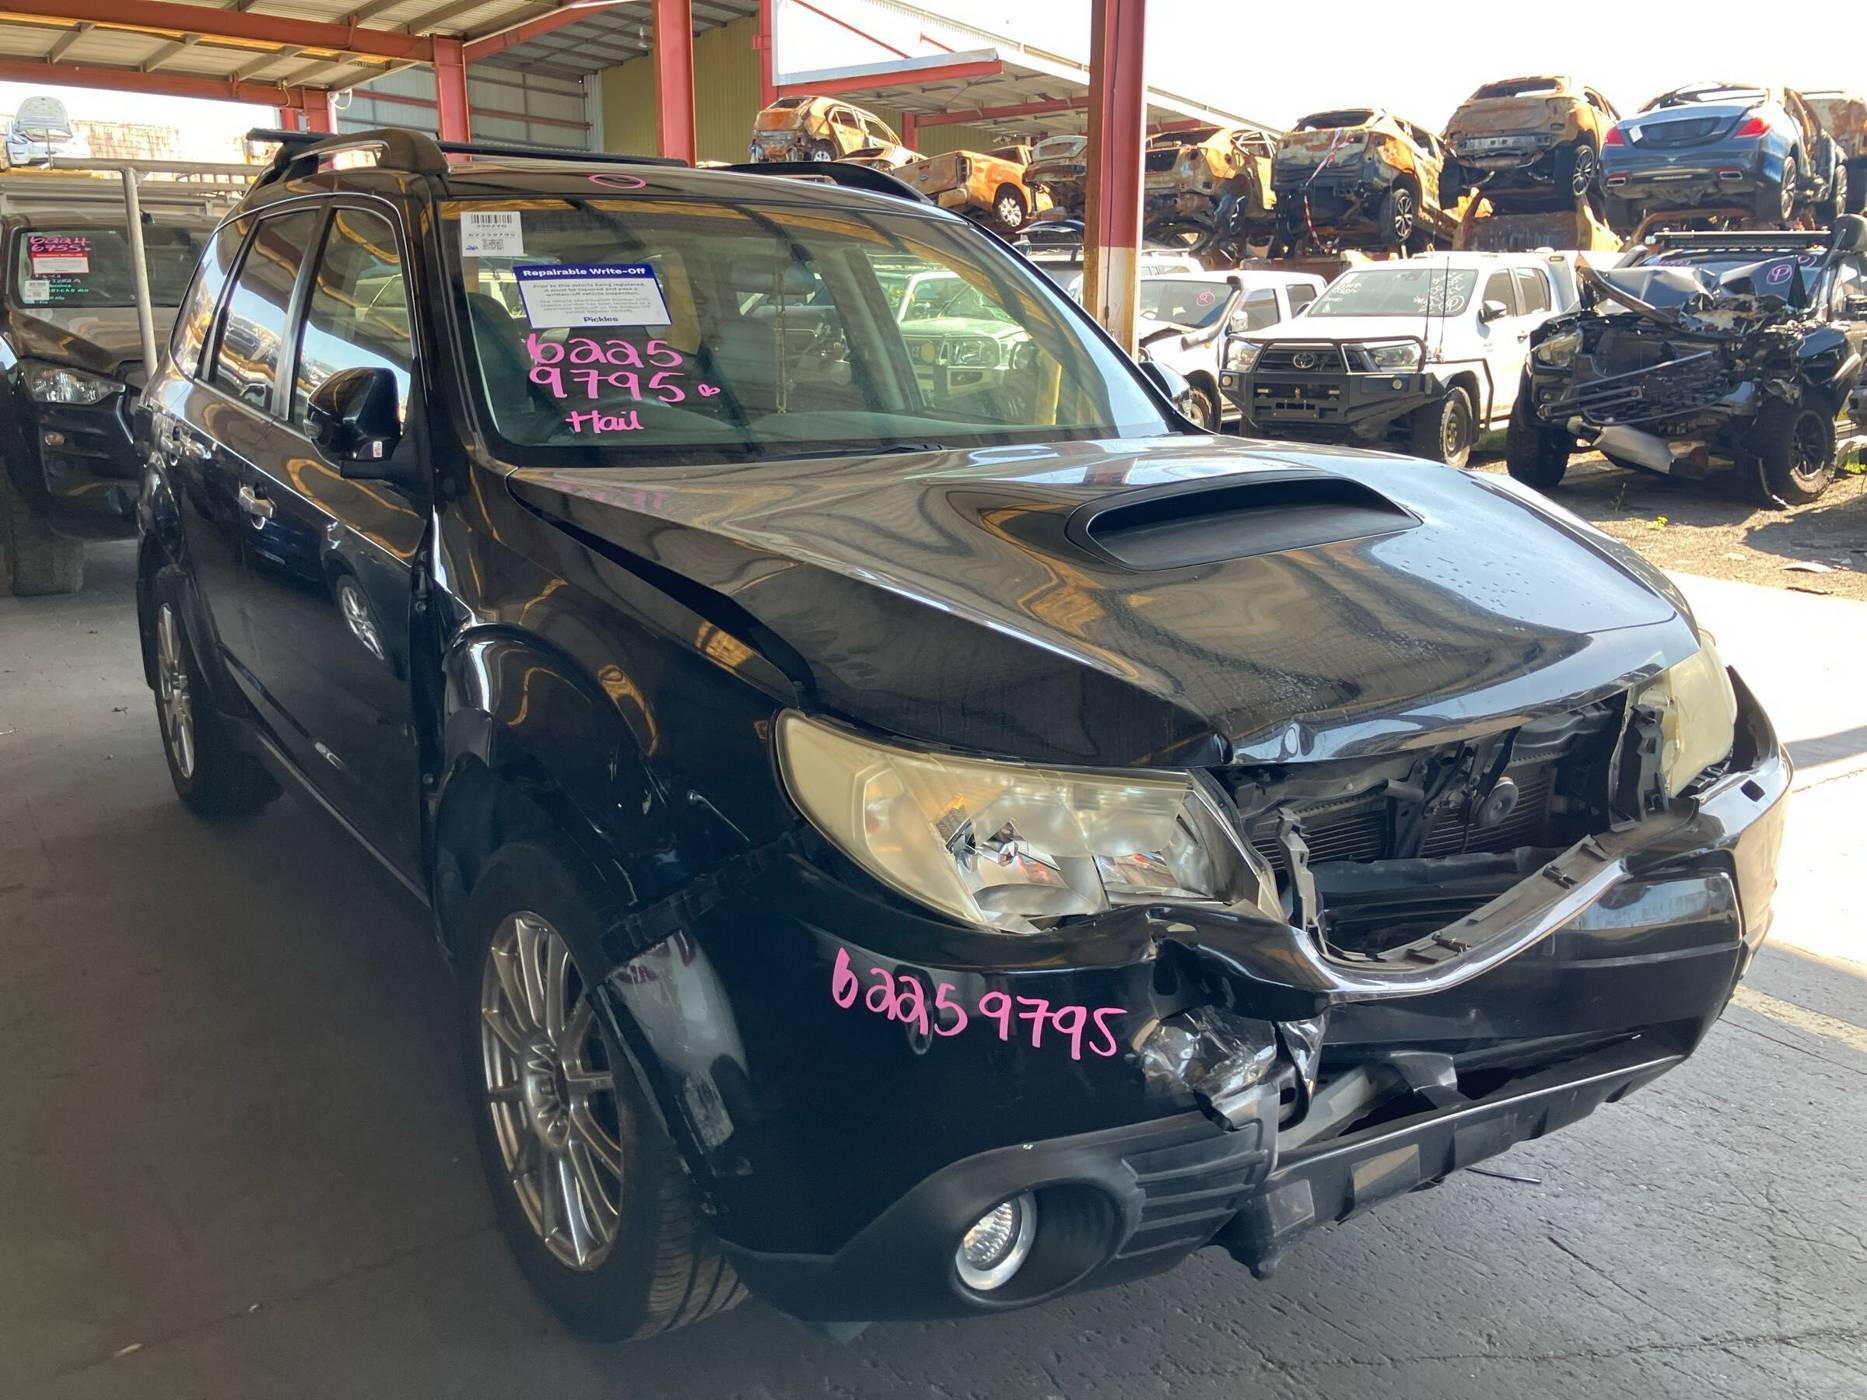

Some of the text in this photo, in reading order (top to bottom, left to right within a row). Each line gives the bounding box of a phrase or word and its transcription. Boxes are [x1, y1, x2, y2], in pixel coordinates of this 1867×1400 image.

[522, 267, 646, 277] Repairable Write-Off
[528, 366, 687, 403] 9795
[564, 409, 645, 434] Hail
[978, 991, 1128, 1061] 9795
